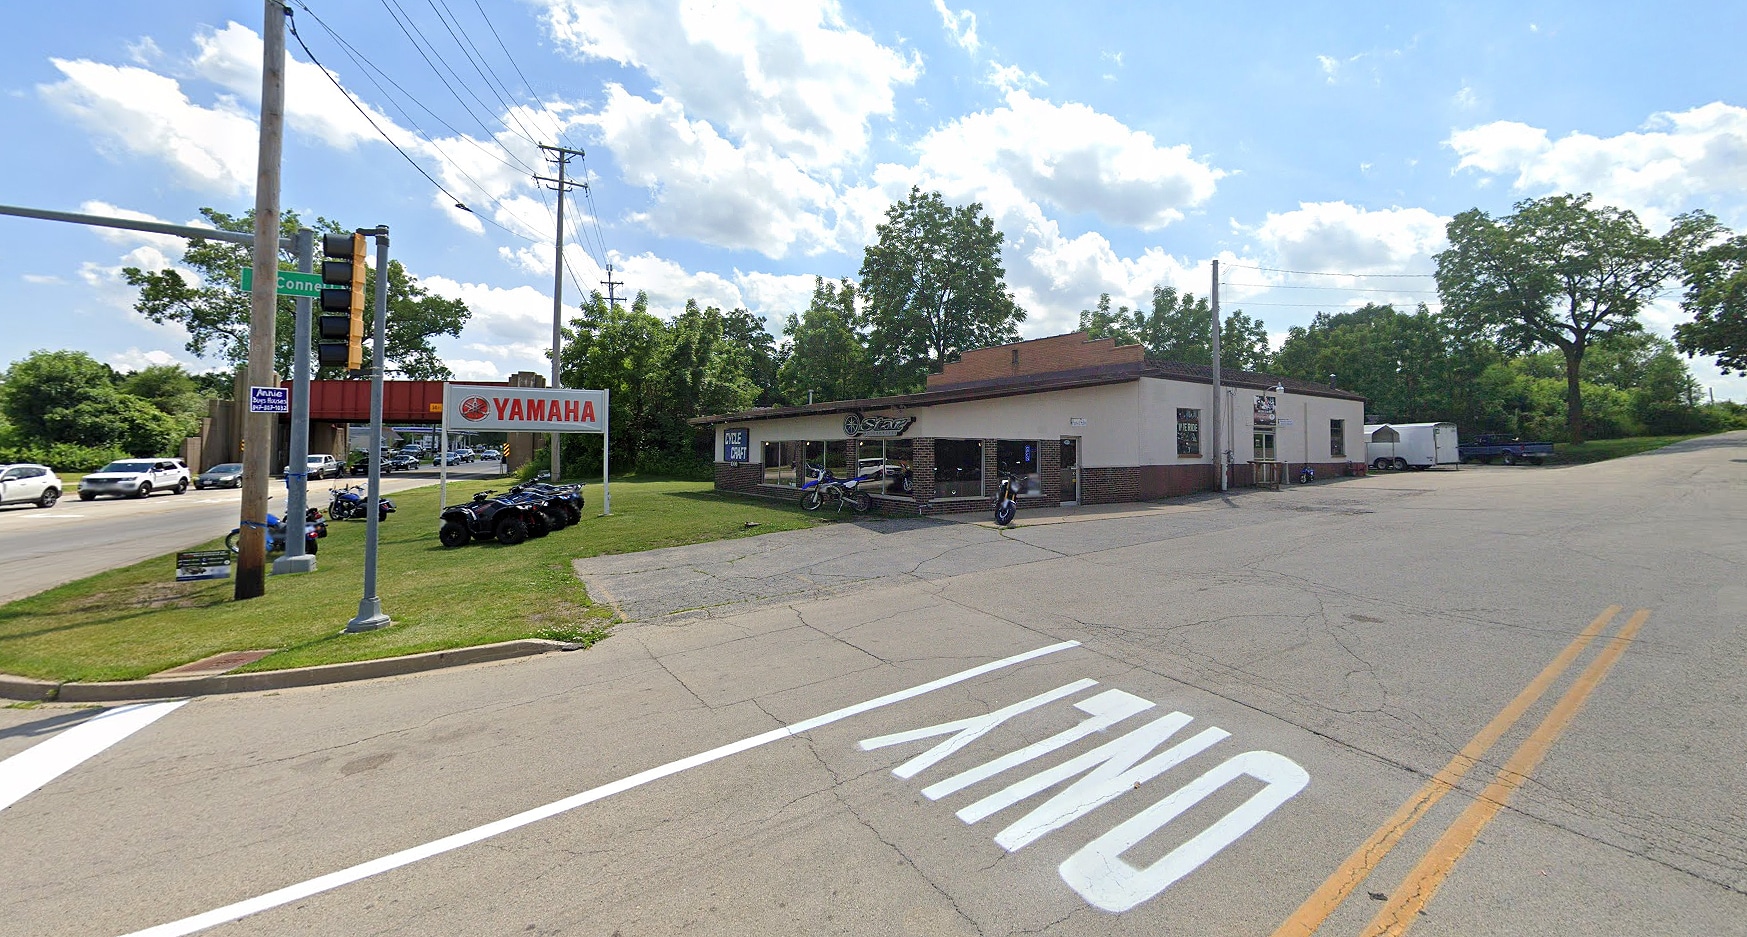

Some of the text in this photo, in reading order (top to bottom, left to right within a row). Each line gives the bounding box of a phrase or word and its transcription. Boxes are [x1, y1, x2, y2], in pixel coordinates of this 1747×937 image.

[276, 277, 334, 292] Conne
[256, 389, 283, 397] Annie
[493, 398, 596, 422] YAMAHA
[861, 416, 910, 432] Star
[725, 432, 742, 445] CYCLE
[731, 446, 747, 460] CRAFT
[858, 678, 1311, 913] ONLY
